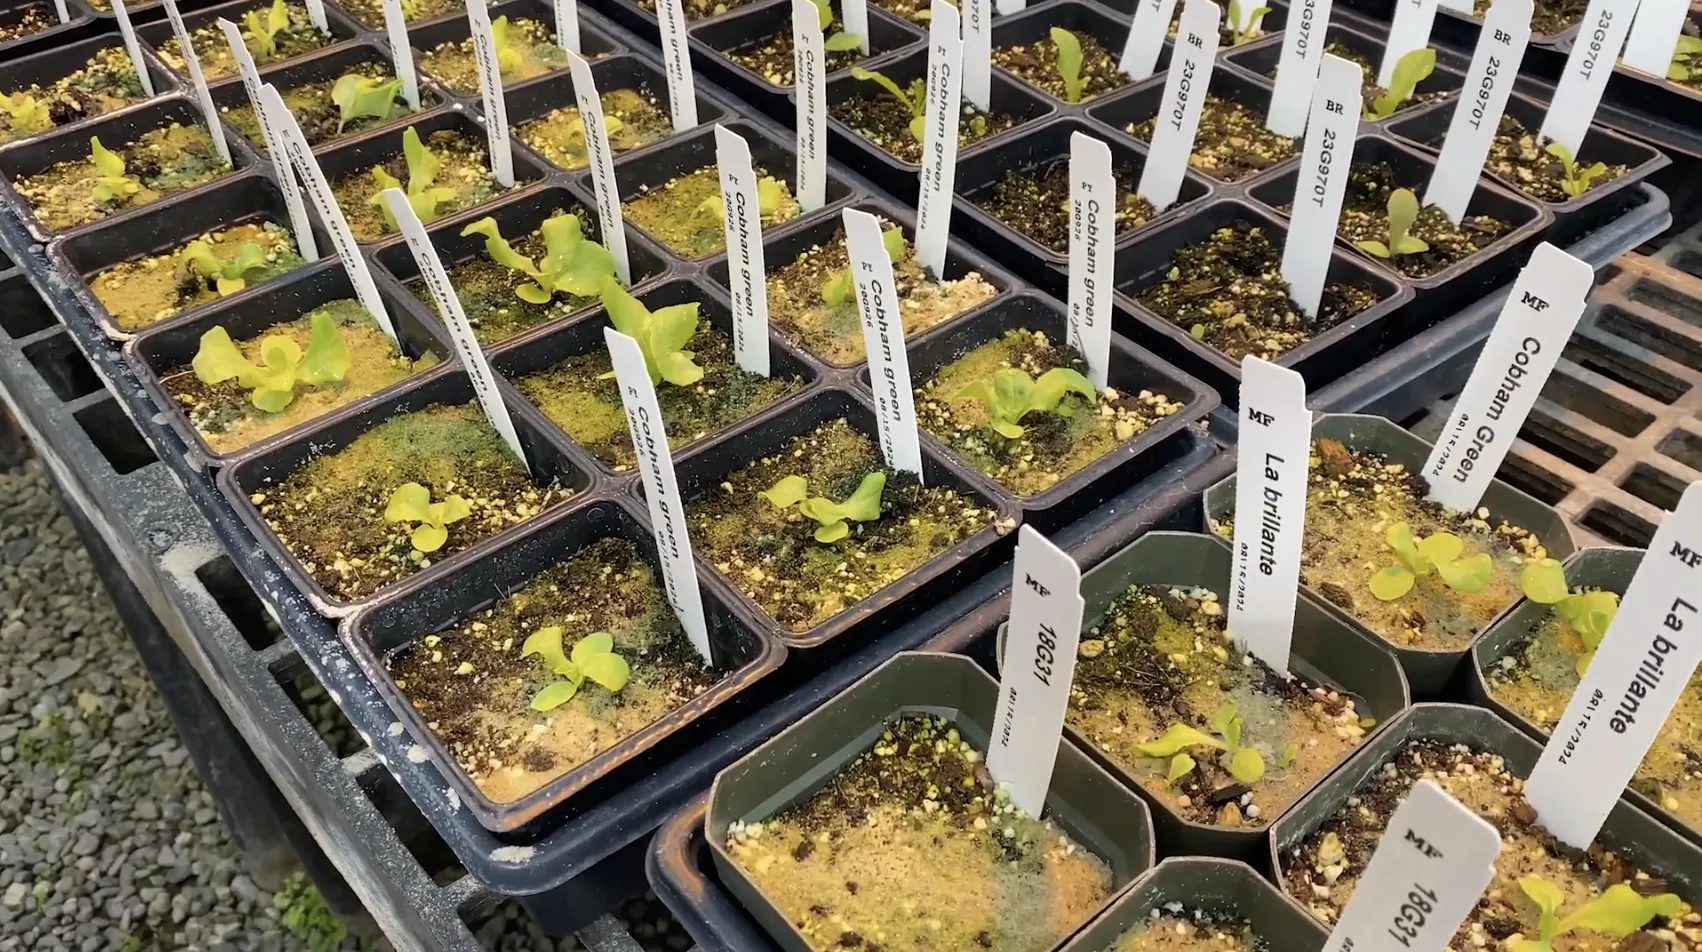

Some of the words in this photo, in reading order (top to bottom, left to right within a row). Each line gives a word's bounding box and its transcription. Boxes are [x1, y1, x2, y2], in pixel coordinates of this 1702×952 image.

[1187, 32, 1203, 49] BR
[1296, 0, 1315, 59] 3G970T
[1493, 29, 1511, 45] BR
[1580, 10, 1612, 80] 23G970T
[806, 49, 815, 114] Cobham
[938, 63, 951, 138] Cobham
[1171, 59, 1195, 131] 23G970T
[1325, 99, 1344, 115] BR
[1469, 56, 1500, 132] 23G970T
[588, 111, 605, 180] Cobham
[600, 182, 614, 229] green
[806, 116, 815, 160] green
[934, 142, 944, 192] green
[1312, 128, 1336, 208] 23G970T
[292, 141, 330, 214] Cobham
[330, 220, 356, 268] green
[736, 192, 750, 265] Cobham
[1087, 199, 1099, 276] Cobham
[421, 252, 461, 332] Cobham
[461, 339, 488, 391] green
[741, 268, 754, 317] green
[1083, 277, 1095, 327] green
[1521, 291, 1550, 312] MF
[871, 279, 891, 362] Cobham
[884, 367, 901, 421] green
[1486, 337, 1541, 420] Cobham
[1248, 407, 1275, 427] MF
[638, 406, 665, 497] Cobham
[658, 499, 680, 559] green
[1265, 453, 1285, 482] La
[1453, 425, 1495, 483] Green
[1259, 486, 1283, 576] brillante
[1025, 572, 1051, 597] MF
[1664, 597, 1698, 632] La
[1033, 623, 1057, 687] 18G31
[1610, 634, 1678, 735] brillante
[1404, 828, 1444, 860] MF
[1388, 883, 1438, 948] 18G31
